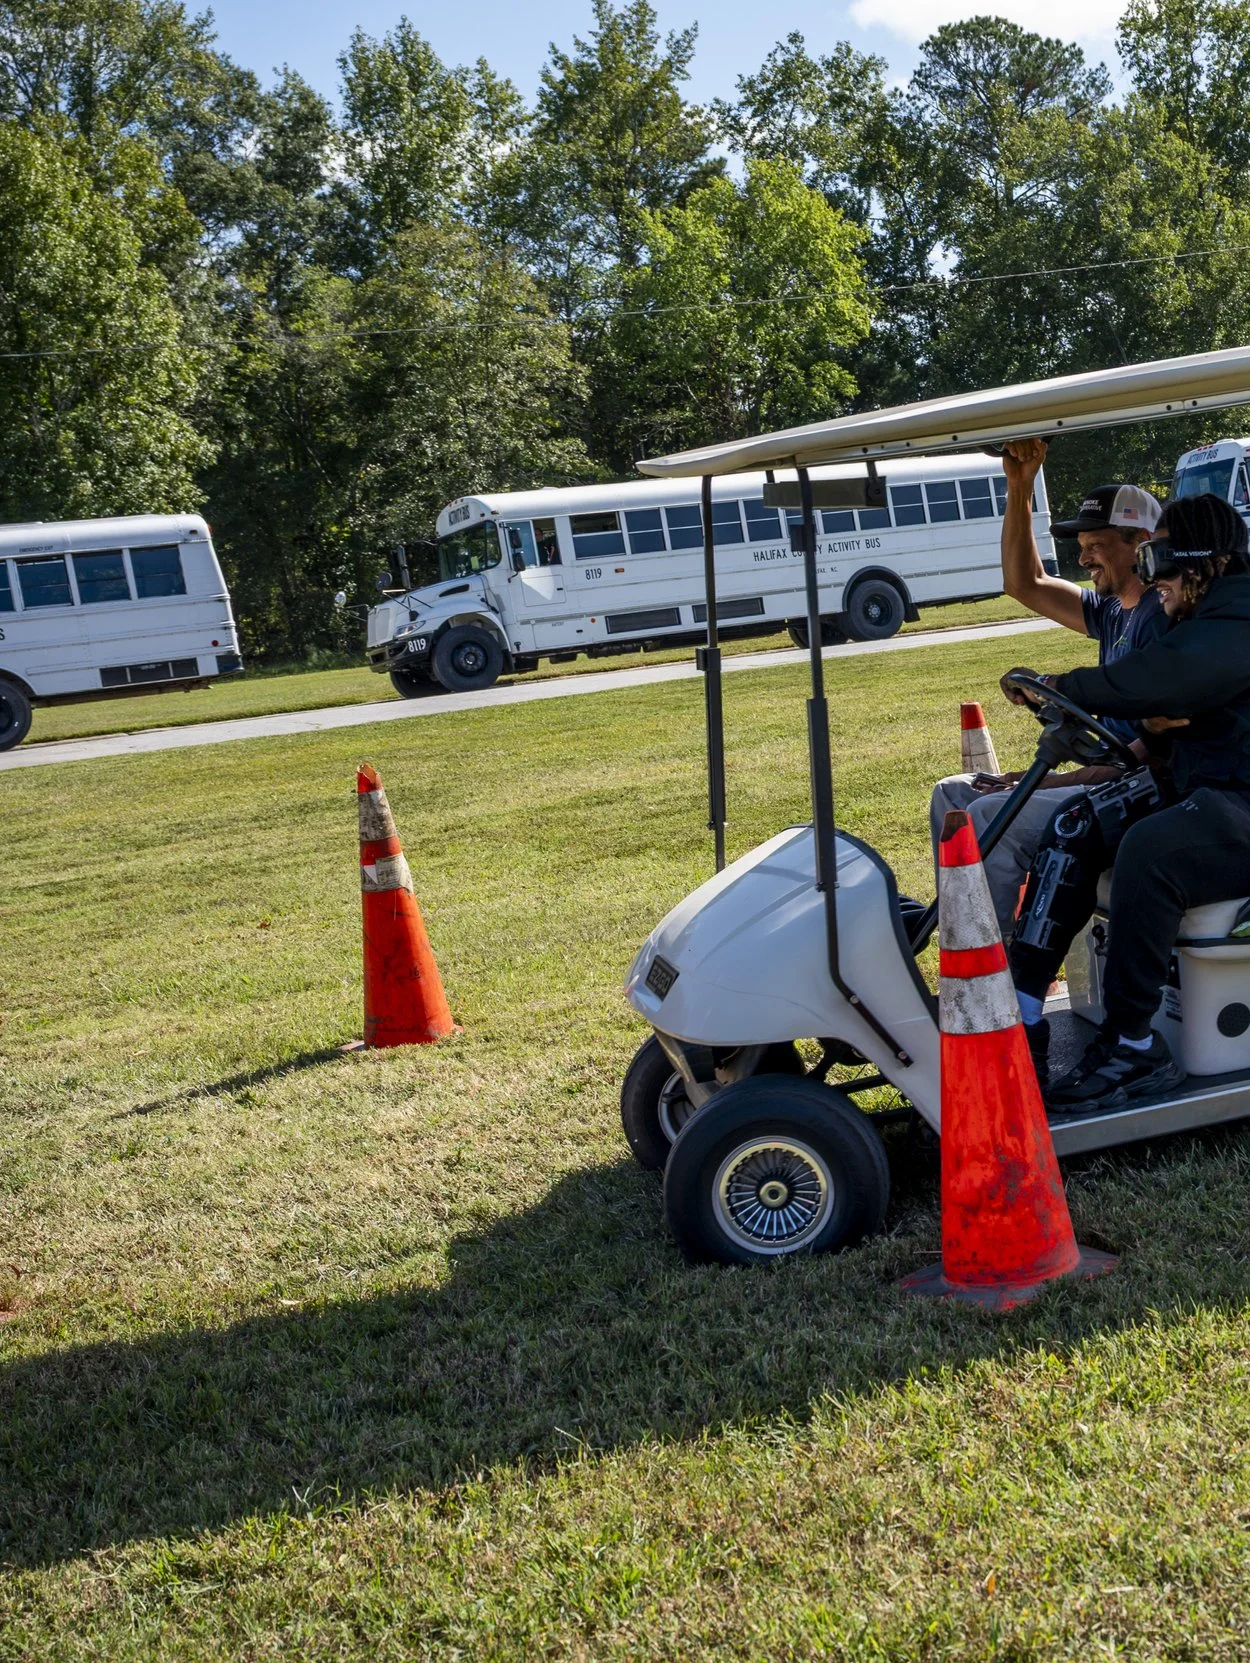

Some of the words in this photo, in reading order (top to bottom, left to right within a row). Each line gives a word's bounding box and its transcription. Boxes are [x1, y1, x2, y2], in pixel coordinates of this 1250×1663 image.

[1189, 451, 1207, 464] ACTIVITY
[1207, 448, 1219, 460] BUS
[753, 548, 788, 562] HALIFAX
[828, 540, 861, 554] ACTIVITY
[865, 537, 881, 549] BUS
[585, 568, 602, 580] 8119
[408, 638, 427, 653] 8119
